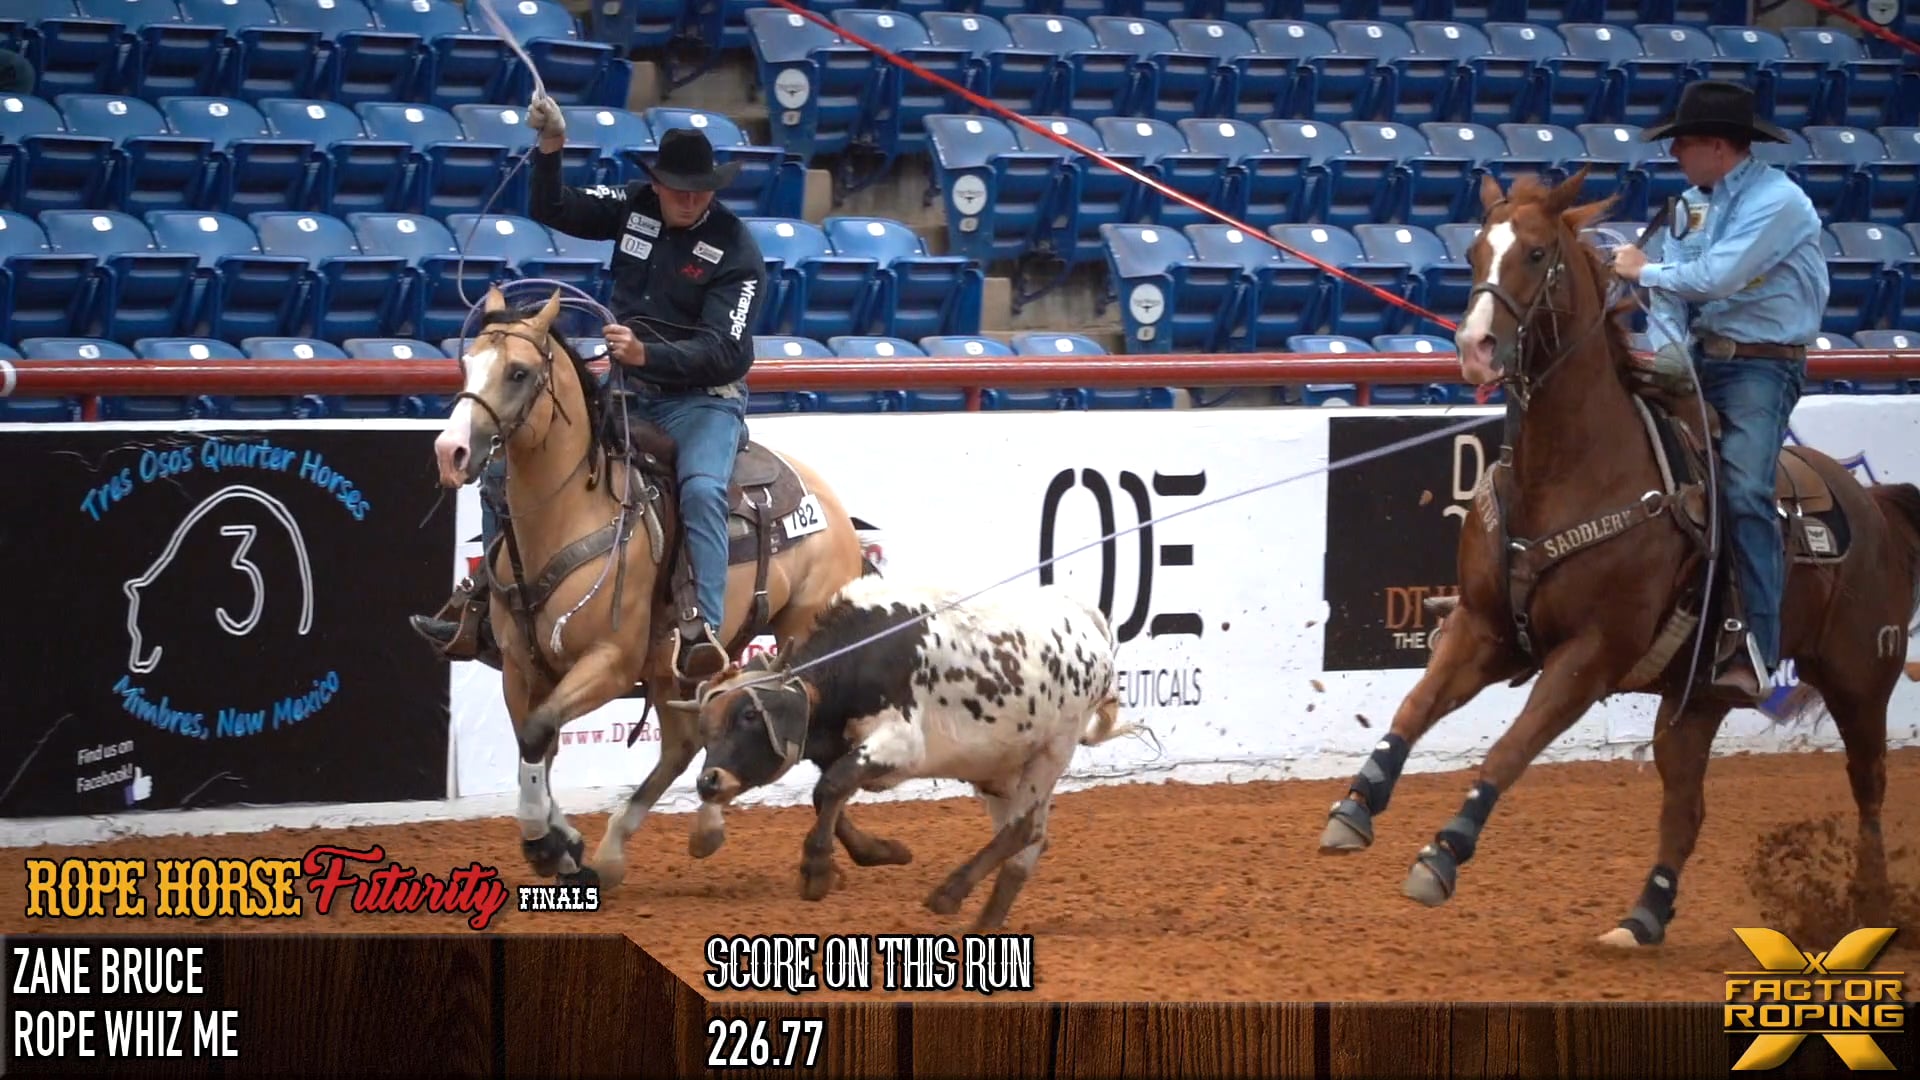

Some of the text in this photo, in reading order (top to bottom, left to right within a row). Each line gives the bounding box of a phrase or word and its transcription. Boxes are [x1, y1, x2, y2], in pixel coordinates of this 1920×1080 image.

[728, 279, 758, 340] Wrangler
[80, 436, 370, 521] Tres Osos Quarter Horses
[1543, 510, 1632, 558] SADDLERY
[1392, 632, 1426, 650] THE
[112, 671, 340, 740] Mimbres, New Mexico
[1117, 668, 1202, 707] EUTICALS
[78, 740, 134, 766] Find us on
[77, 763, 133, 793] Facebook!
